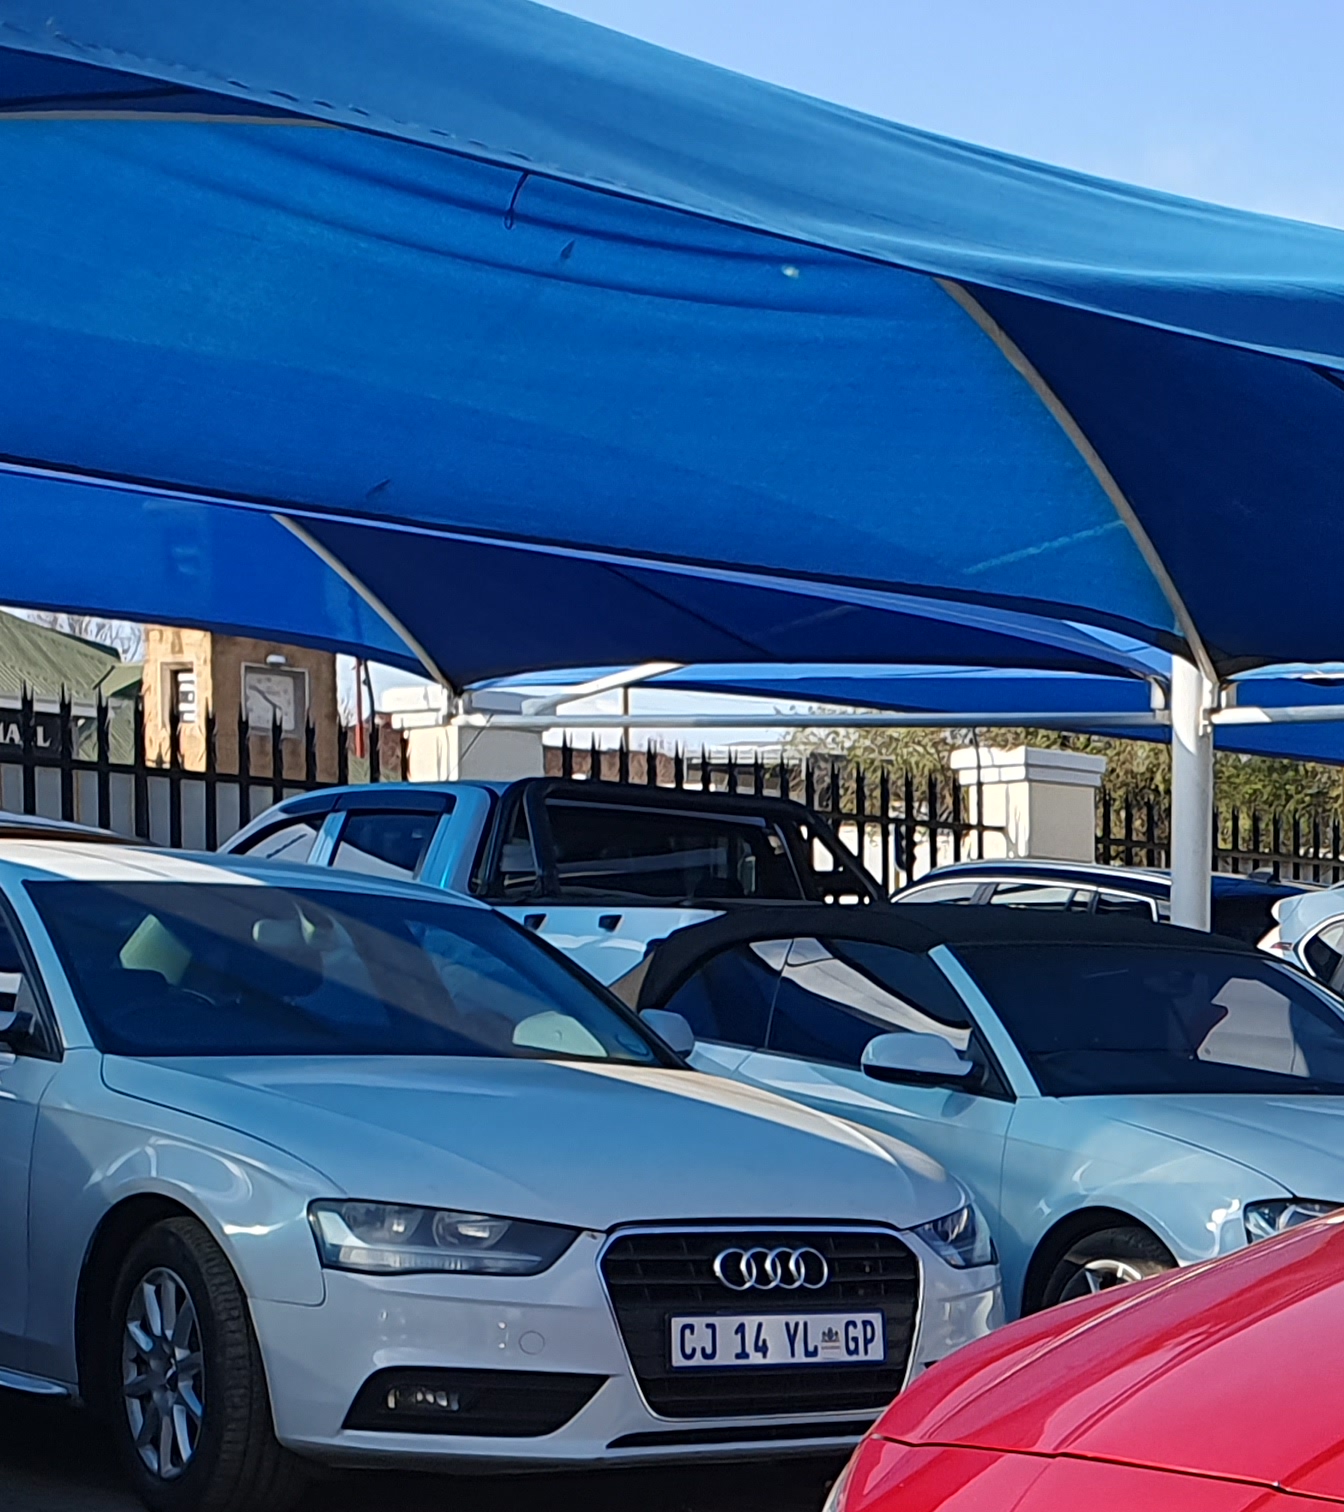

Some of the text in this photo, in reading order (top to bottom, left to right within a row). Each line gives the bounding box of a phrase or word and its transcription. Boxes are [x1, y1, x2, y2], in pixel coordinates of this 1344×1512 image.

[679, 1319, 876, 1361] CJ 14 YL GP
